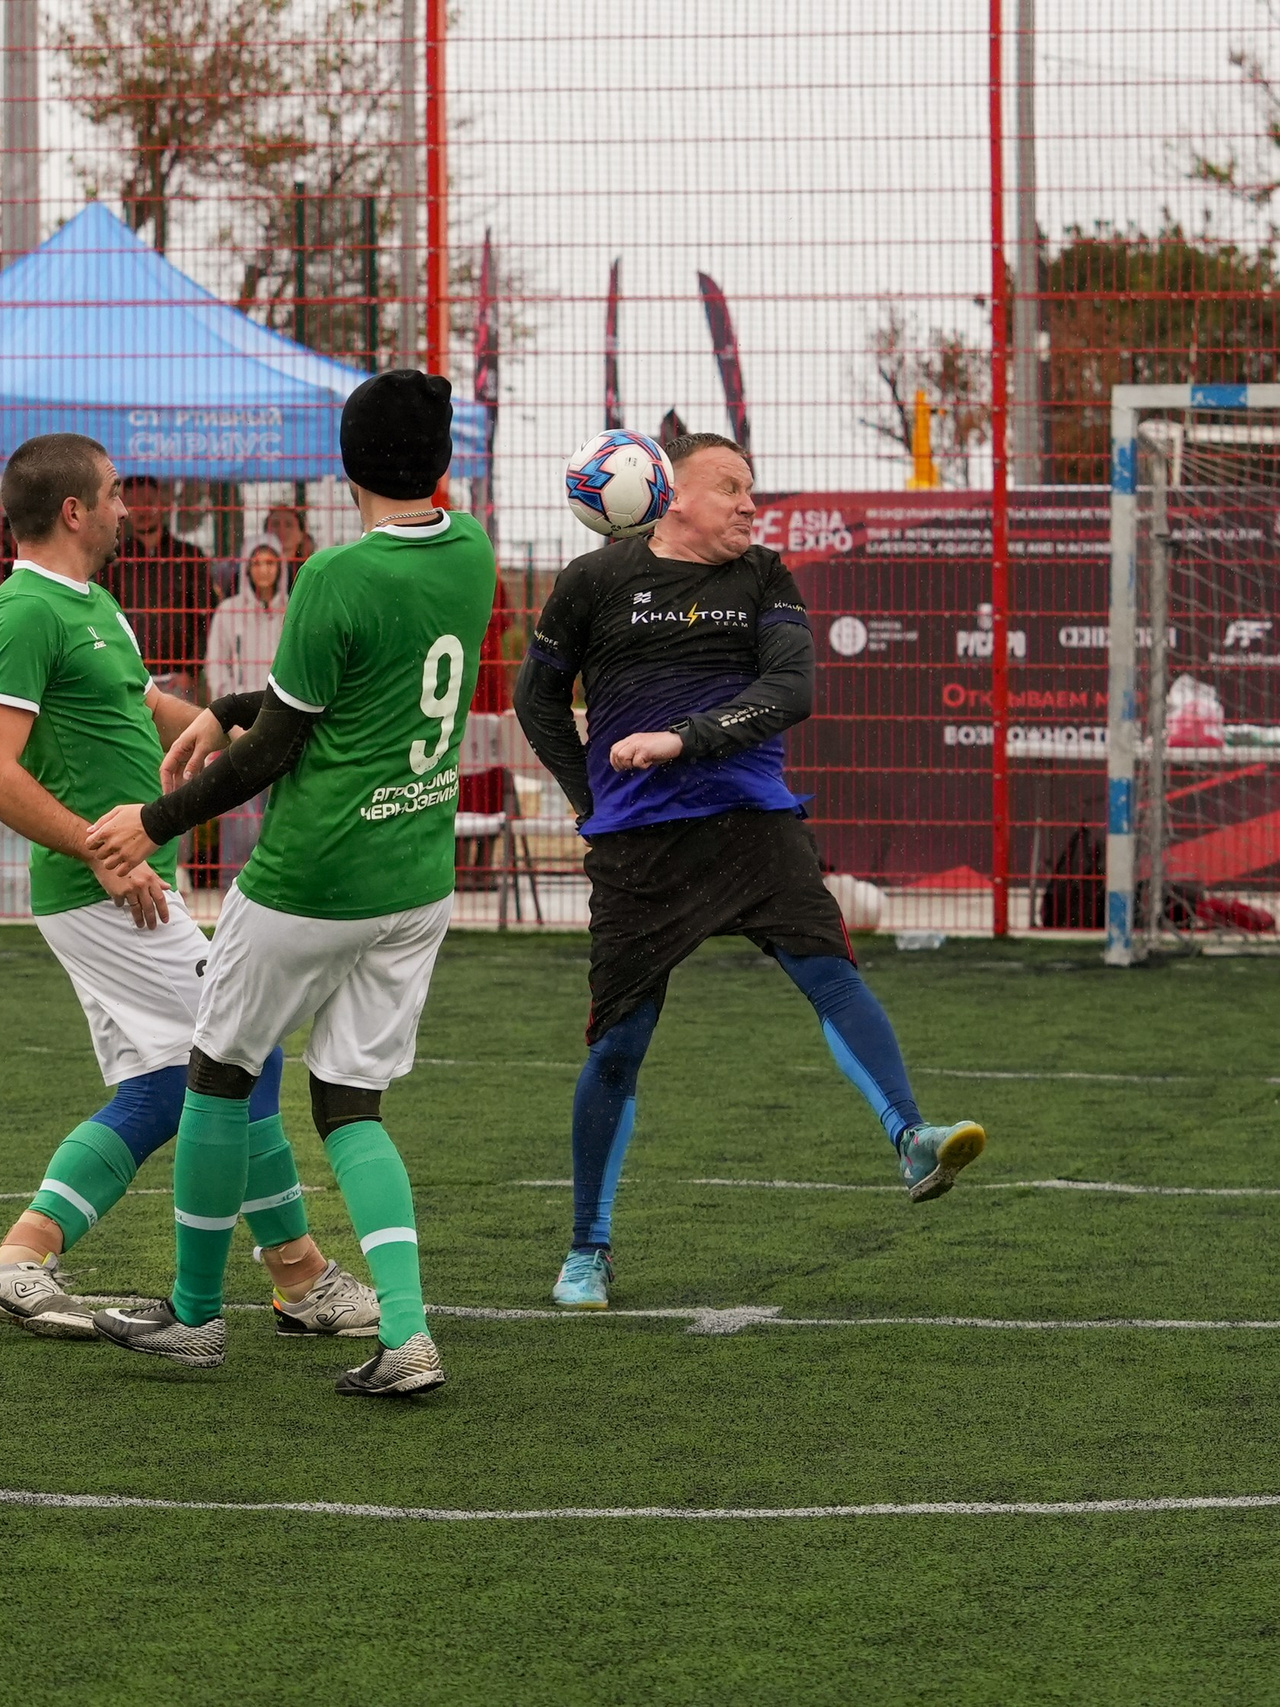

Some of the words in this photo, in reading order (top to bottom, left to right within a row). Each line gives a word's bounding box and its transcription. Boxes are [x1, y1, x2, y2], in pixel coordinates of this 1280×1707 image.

[788, 510, 845, 530] ASIA
[788, 530, 853, 551] EXPO
[409, 634, 465, 776] 9
